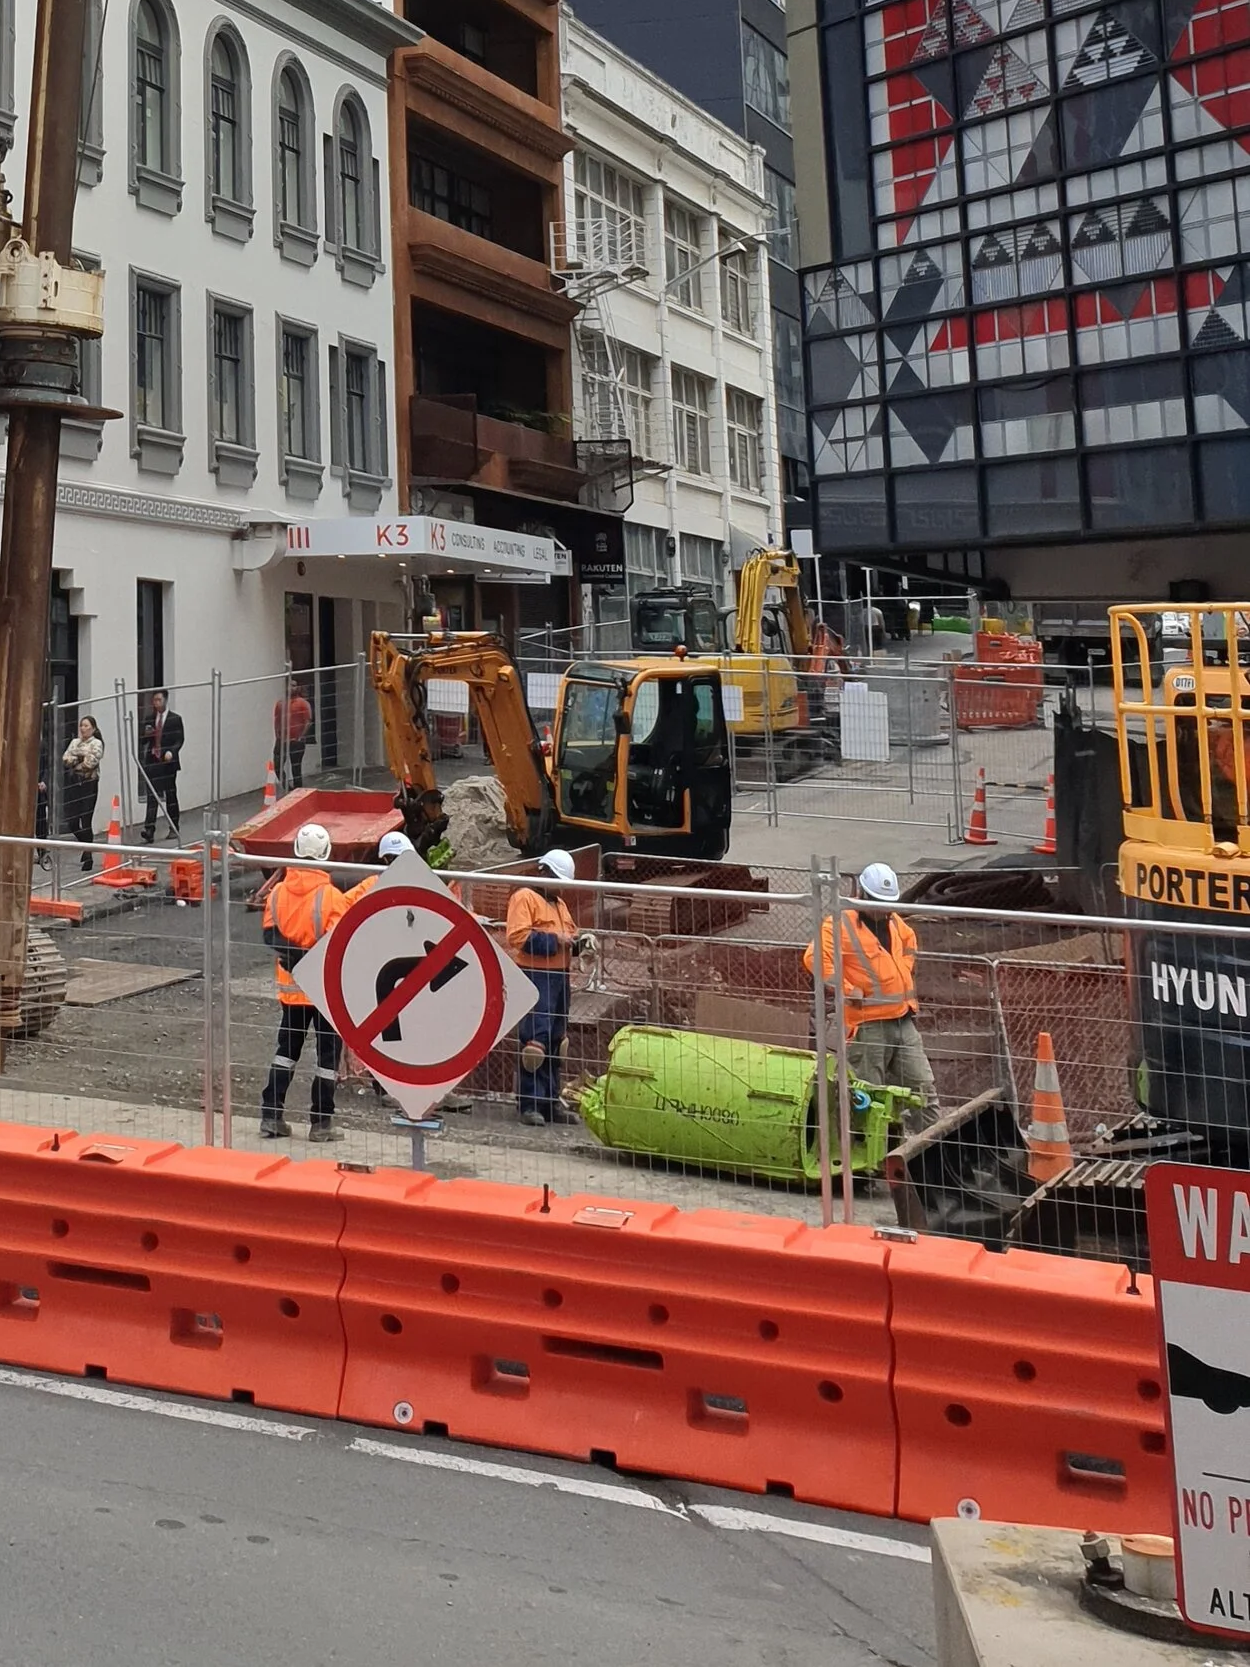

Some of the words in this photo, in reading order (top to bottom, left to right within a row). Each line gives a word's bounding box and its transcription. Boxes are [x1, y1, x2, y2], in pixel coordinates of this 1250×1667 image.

[377, 524, 409, 546] K3
[431, 522, 446, 551] K3
[451, 532, 486, 551] CONSULTING
[493, 539, 526, 558] ACCOUNTING
[533, 546, 548, 562] LEGAL
[581, 563, 624, 573] RAKUTEN
[1182, 1487, 1214, 1531] NO
